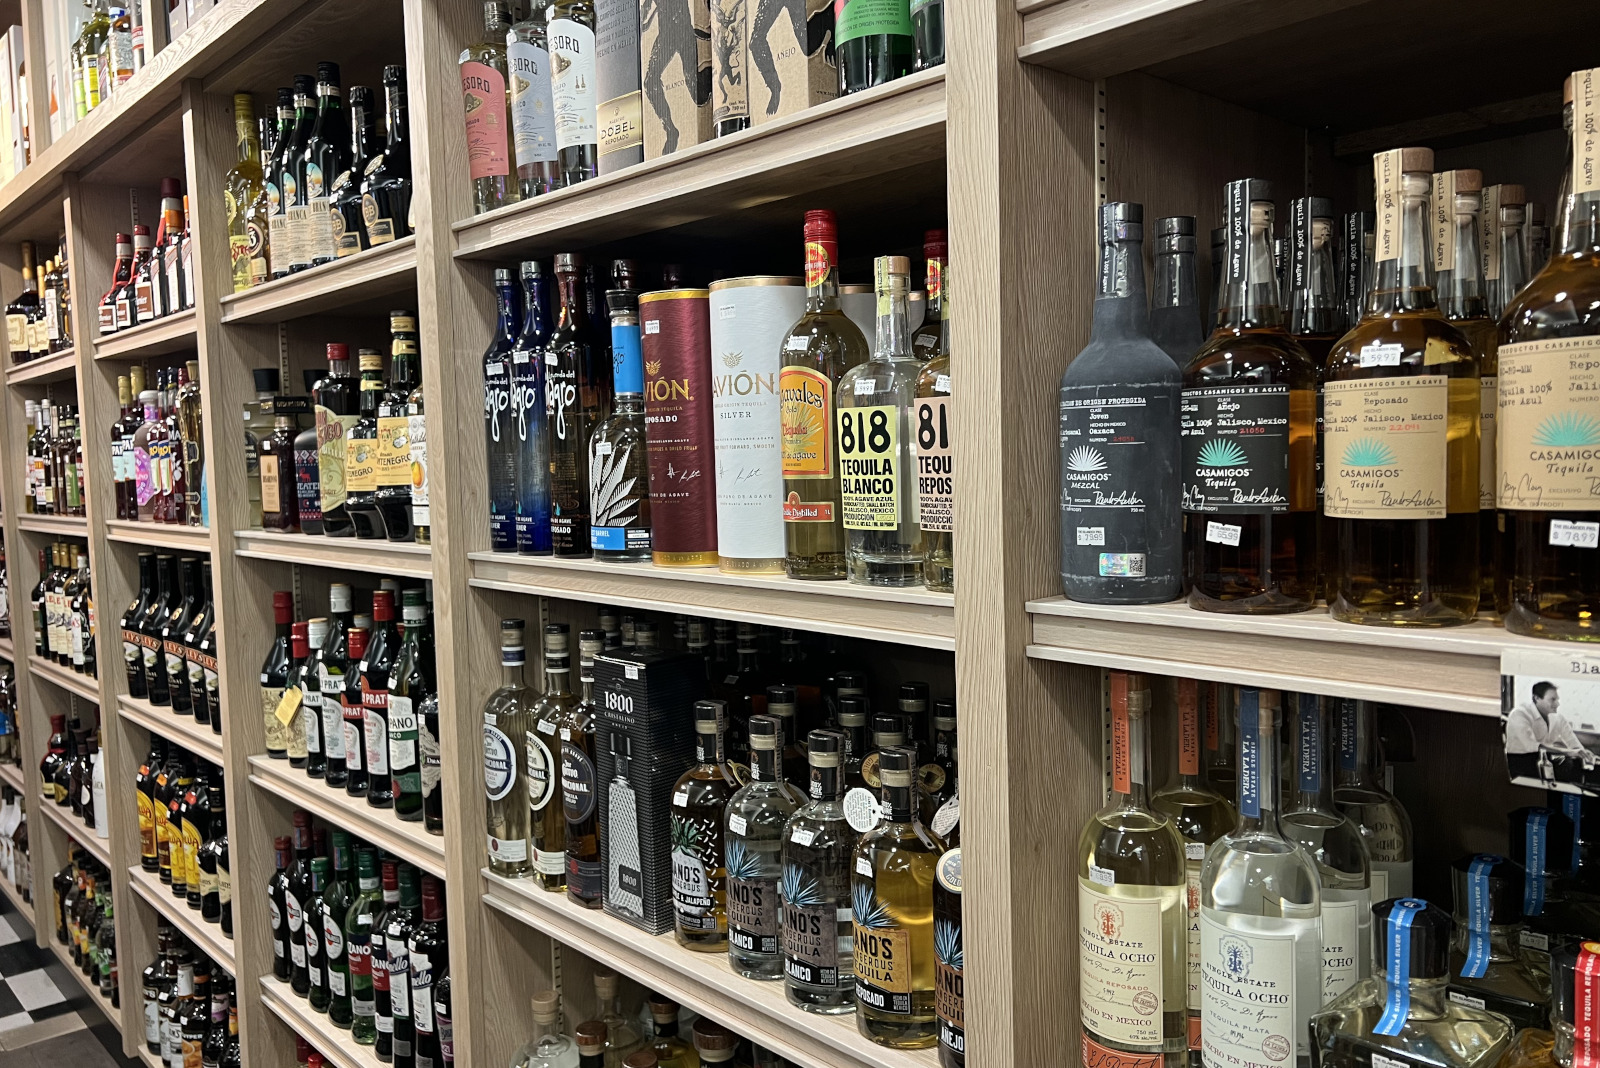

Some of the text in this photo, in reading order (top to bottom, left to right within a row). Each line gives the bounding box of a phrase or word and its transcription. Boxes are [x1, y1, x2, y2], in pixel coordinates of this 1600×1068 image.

[776, 47, 797, 62] AÑEJO
[665, 79, 686, 92] BLANCO
[601, 120, 635, 140] DOBEL
[605, 133, 630, 146] REPOSADO
[1583, 112, 1598, 186] 100% de Agave
[288, 210, 307, 220] BRANCA
[1438, 204, 1448, 224] 100%
[1234, 217, 1243, 237] 100%
[1384, 188, 1395, 255] 100% de Agave
[1235, 240, 1242, 250] de
[1297, 229, 1305, 248] 100%
[1437, 242, 1445, 266] Agave
[713, 370, 775, 398] AVIÓN
[1350, 381, 1395, 389] CASAMIGOS
[1529, 381, 1553, 395] 100%
[1217, 402, 1240, 411] Añejo
[1364, 397, 1409, 407] Reposado
[1520, 397, 1543, 405] Azul
[720, 411, 752, 420] SILVER
[1340, 415, 1357, 423] 100%
[1364, 414, 1405, 423] Jalisco,
[918, 404, 949, 450] 81
[1196, 419, 1213, 427] 100%
[1217, 419, 1256, 427] Jalisco,
[782, 422, 808, 439] Tequila
[841, 410, 891, 454] 818
[792, 451, 817, 464] agave
[918, 455, 952, 474] TEQU
[842, 458, 893, 476] TEQUILA
[1196, 469, 1250, 477] CASAMIGOS
[1340, 470, 1400, 478] CASAMIGOS
[1547, 463, 1593, 476] Tequila
[843, 478, 894, 495] BLANCO
[920, 477, 952, 495] REPOS
[1205, 478, 1237, 489] Tequila
[1350, 480, 1385, 491] Tequila
[792, 508, 818, 519] Distilled
[844, 513, 875, 521] PRODUCCION
[1566, 529, 1596, 543] 78.99
[1571, 662, 1600, 675] Bla
[305, 695, 319, 703] PRAT
[366, 694, 385, 705] PRAT
[604, 691, 634, 714] 1800
[345, 707, 360, 717] PRAT
[604, 712, 635, 724] CRISTALINO
[1183, 712, 1189, 722] LA
[1242, 741, 1249, 752] LA
[1302, 721, 1310, 773] LA LADERA
[570, 750, 583, 762] AGAVE
[622, 873, 637, 887] 1800
[946, 873, 962, 887] GOLD
[685, 896, 711, 906] JALAPEÑO
[729, 928, 753, 950] BLANCO
[1083, 926, 1144, 949] SINGLE ESTATE
[1080, 934, 1156, 963] TEQUILA OCHO
[784, 962, 811, 982] BLANCO
[1112, 966, 1146, 982] De Agave
[1207, 962, 1276, 988] SINGLE ESTATE
[1082, 968, 1149, 991] TEQUILA REPOSADO
[1202, 969, 1290, 1004] TEQUILA OCHO
[1458, 995, 1474, 1003] ISLANDER
[1584, 990, 1592, 1021] TEQUILA
[1102, 1012, 1152, 1027] EN MEXICO
[1210, 1010, 1270, 1035] TEQUILA PLATA
[1240, 1007, 1278, 1024] De Agave
[1385, 1014, 1398, 1035] TEQUILA
[941, 1025, 964, 1051] AÑEJO
[1227, 1053, 1240, 1065] EN
